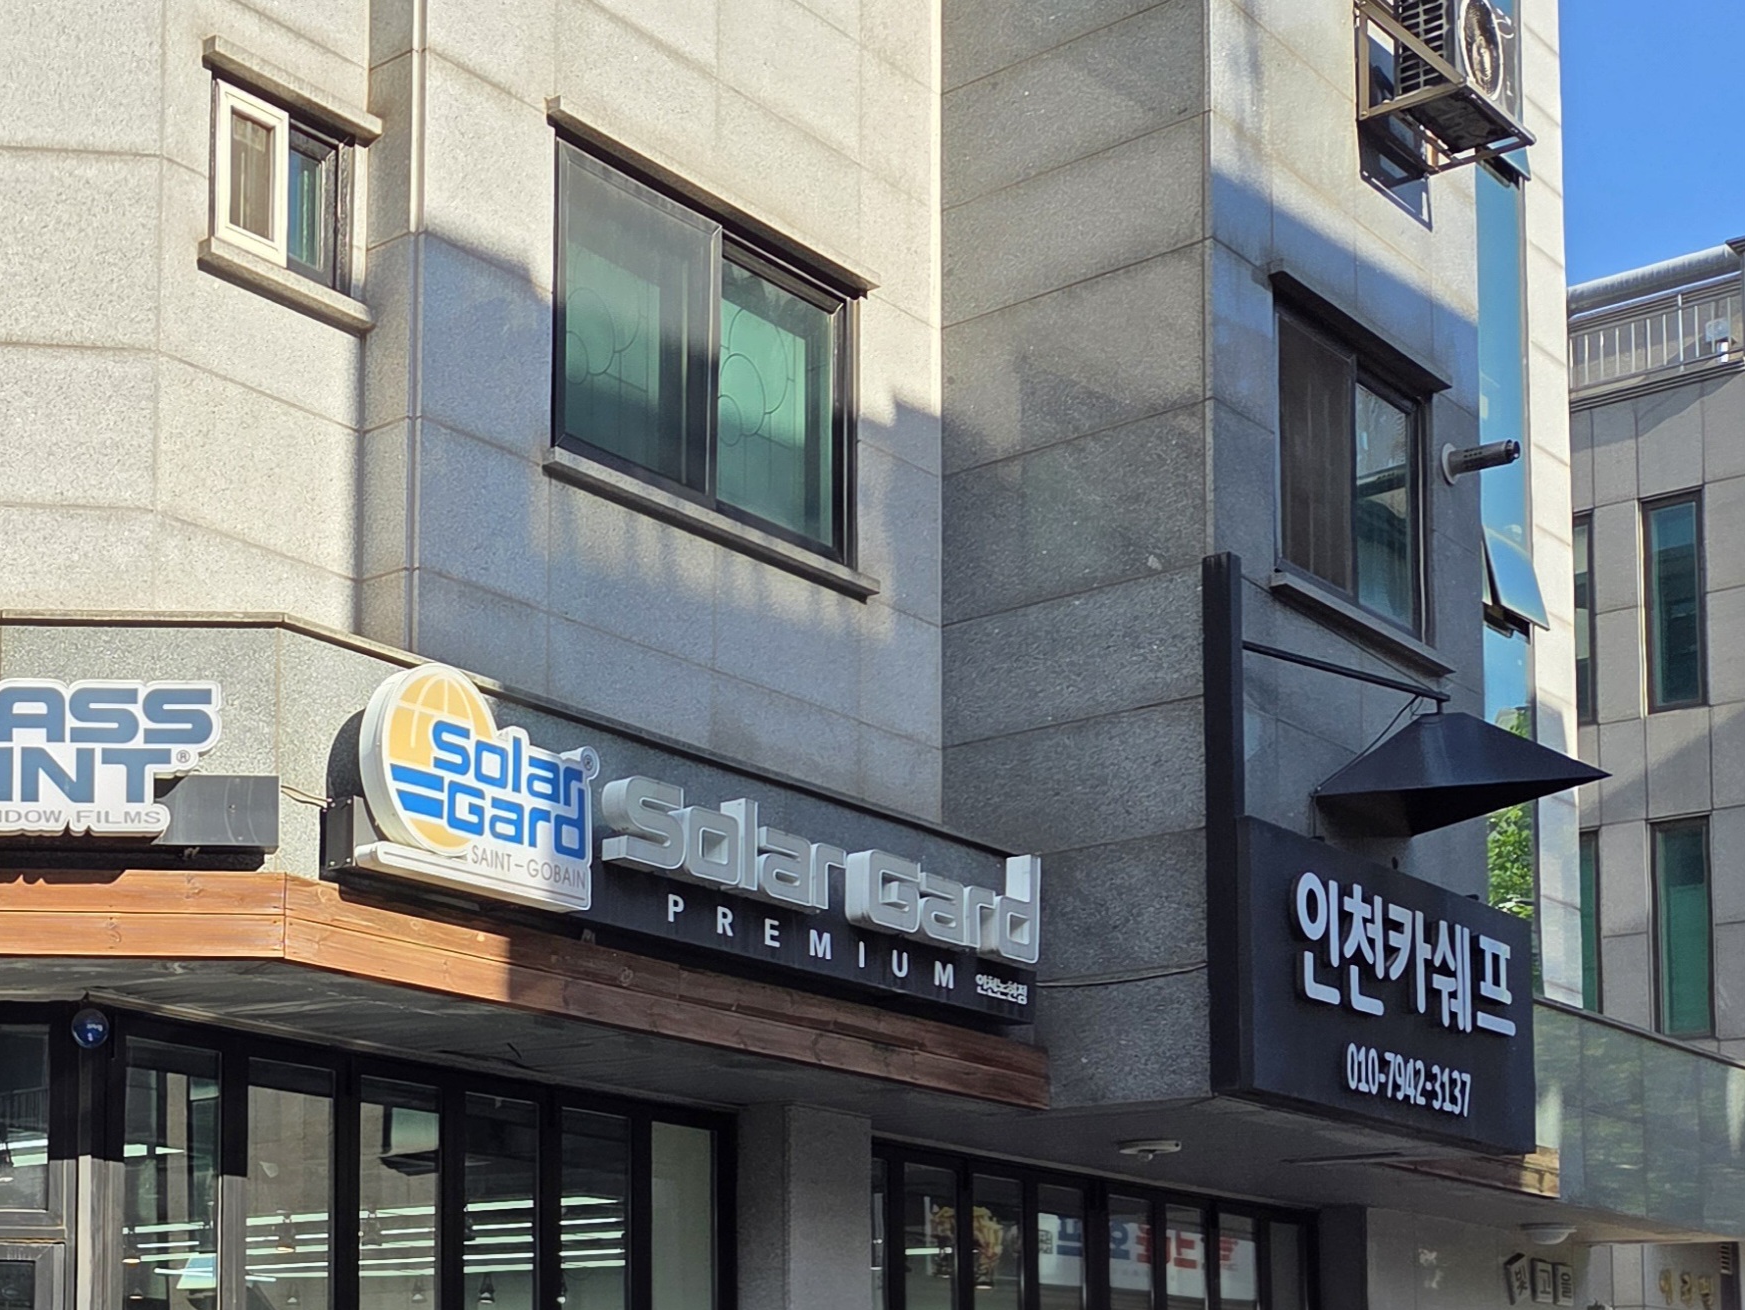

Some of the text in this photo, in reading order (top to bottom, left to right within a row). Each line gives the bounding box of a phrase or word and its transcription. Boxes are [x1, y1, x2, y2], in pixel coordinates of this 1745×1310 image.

[76, 808, 162, 825] FILMS
[445, 784, 585, 861] Gard
[602, 776, 1041, 963] Solar Gard
[668, 893, 956, 990] PREMIUM
[1297, 872, 1516, 1036] 인천카쉐프
[1346, 1043, 1471, 1117] 010-7942-3137
